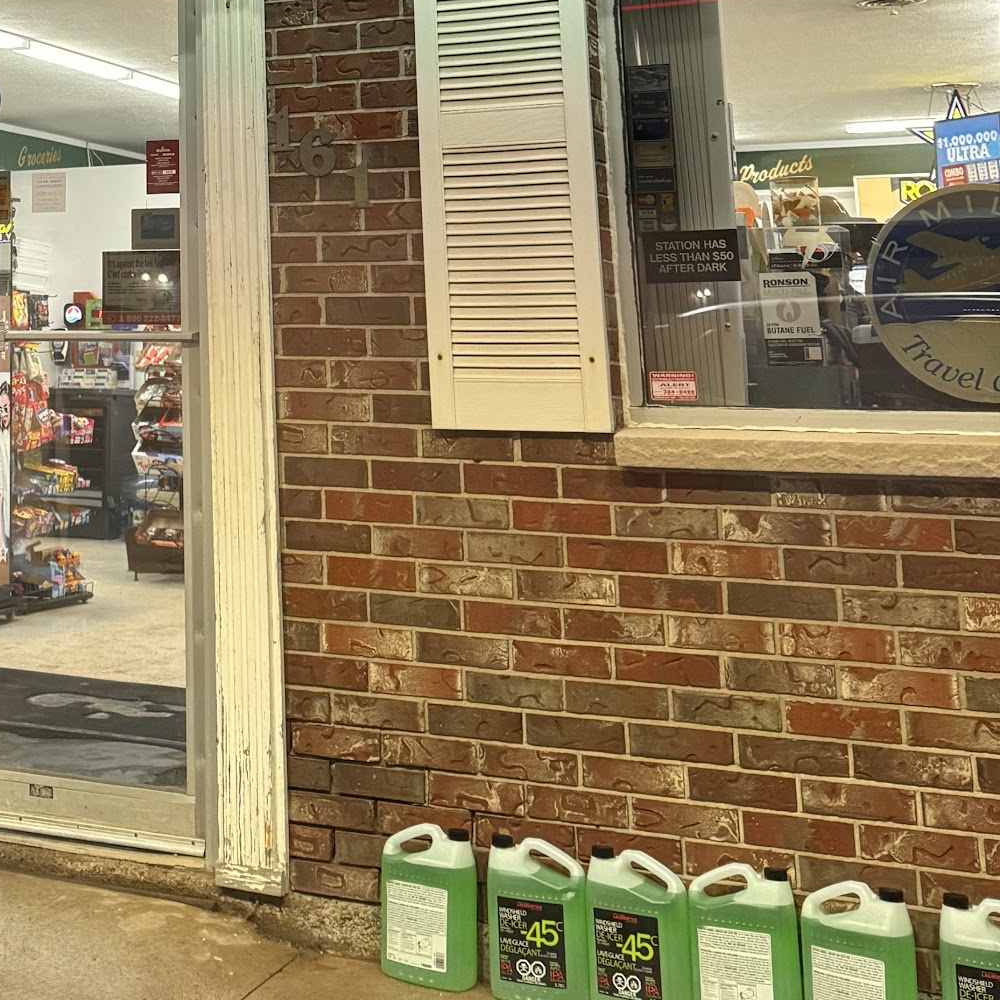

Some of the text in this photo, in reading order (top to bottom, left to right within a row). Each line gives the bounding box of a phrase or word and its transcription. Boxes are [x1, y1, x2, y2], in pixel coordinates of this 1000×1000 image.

[936, 130, 998, 149] $1,000,000
[17, 145, 62, 167] Groceries
[946, 142, 991, 163] ULTRA
[739, 154, 813, 184] Products
[655, 239, 727, 251] STATION HAS
[650, 253, 678, 263] LESS
[680, 252, 710, 262] THAN
[659, 262, 728, 274] AFTER DARK
[763, 278, 808, 288] RONSON
[880, 240, 909, 319] AIR
[126, 314, 141, 322] 800
[796, 326, 816, 334] FUEL
[901, 334, 984, 391] Travel
[499, 906, 527, 916] WINDSHIELD
[499, 911, 521, 921] WASHER
[500, 919, 528, 930] DE-ICER
[595, 918, 623, 928] WINDSHIELD
[596, 924, 617, 933] WASHER
[596, 931, 623, 942] DE-ICER
[957, 975, 994, 988] WINDSHIELD
[958, 981, 987, 993] WASHER
